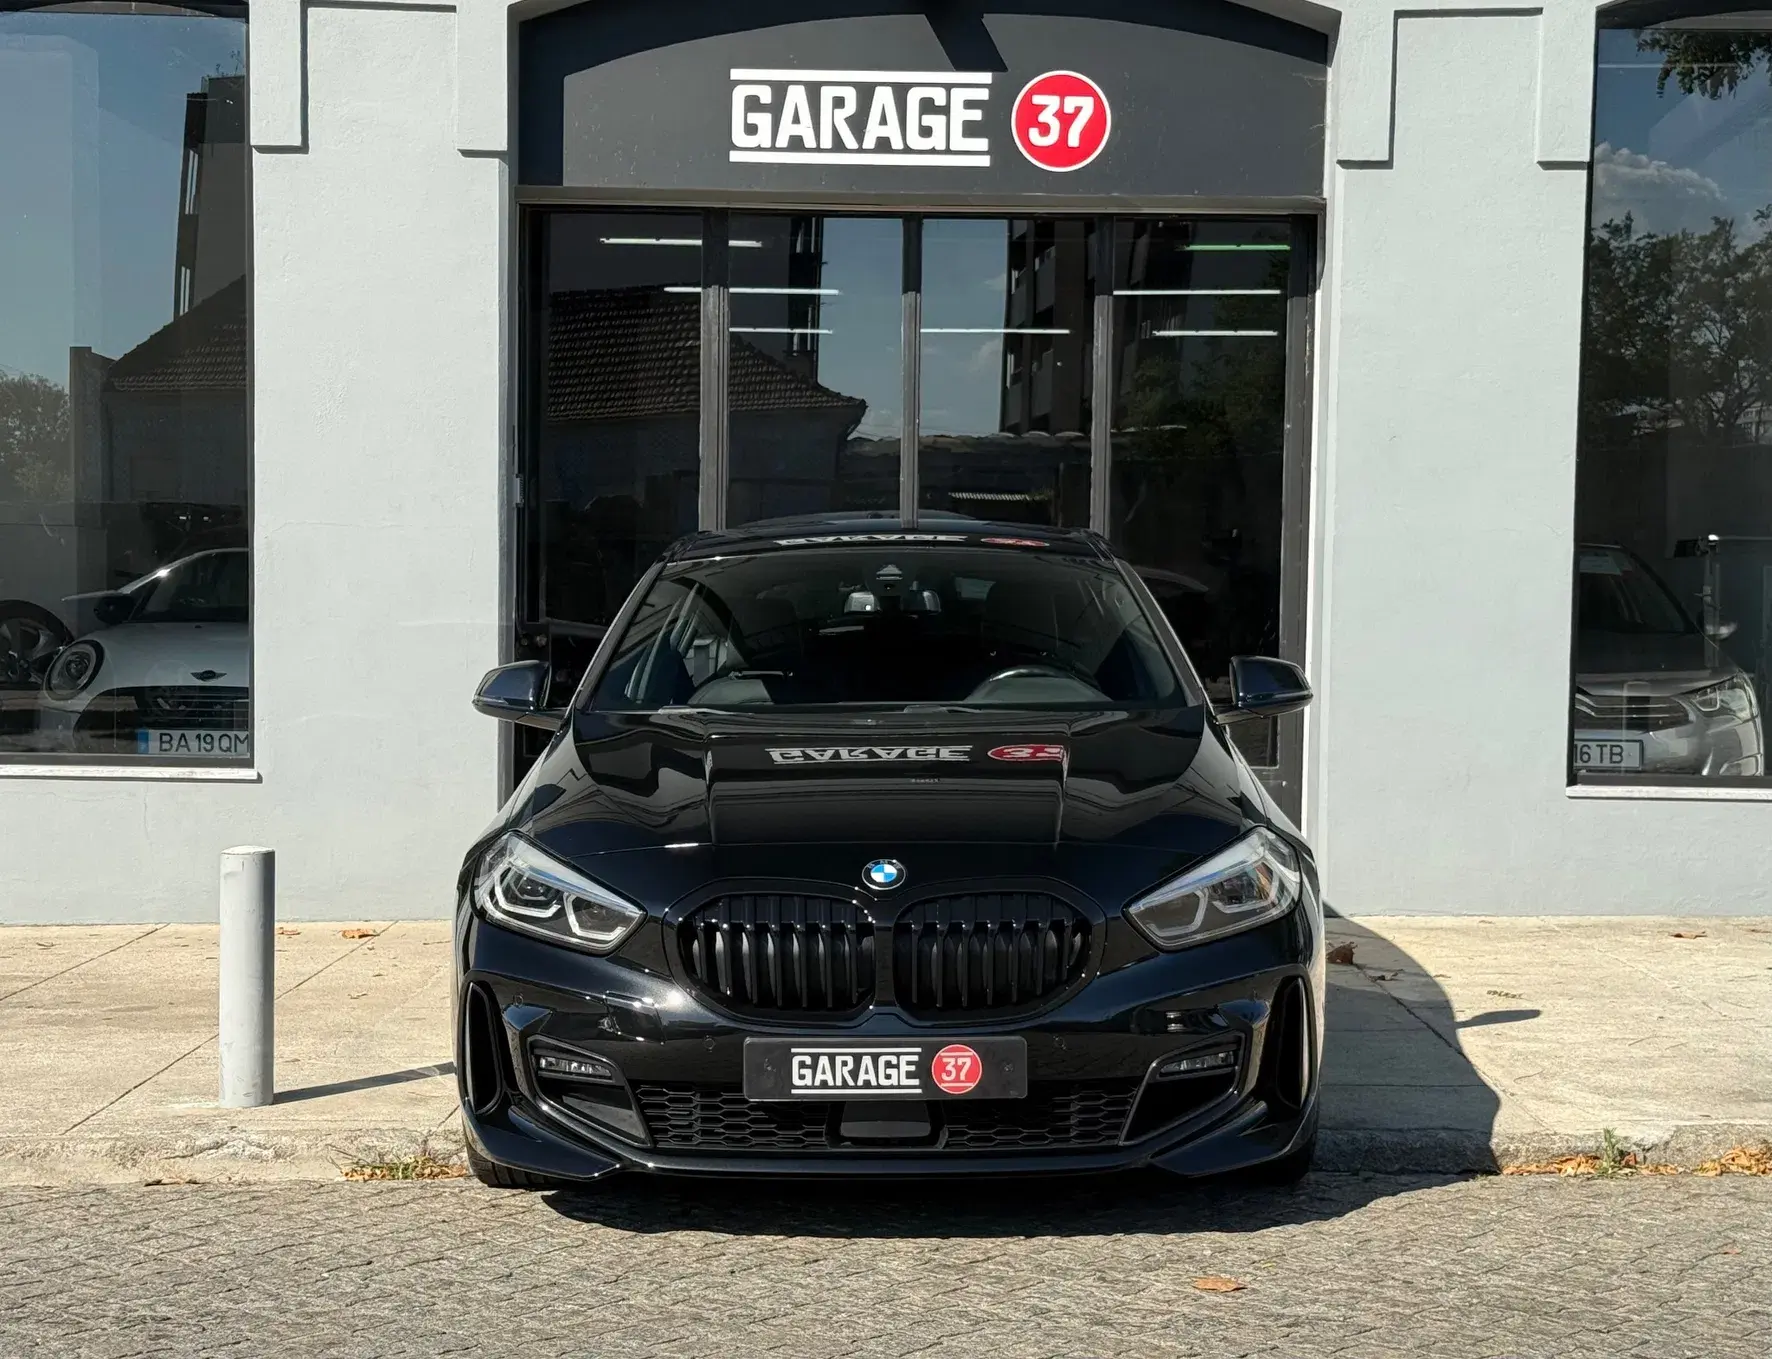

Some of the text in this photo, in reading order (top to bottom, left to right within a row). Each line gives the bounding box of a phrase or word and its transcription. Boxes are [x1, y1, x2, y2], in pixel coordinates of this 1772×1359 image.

[731, 84, 1094, 151] GARAGE 37
[159, 733, 249, 753] BA 19 QM
[1596, 744, 1623, 763] TB
[792, 1055, 972, 1086] GARAGE 37
